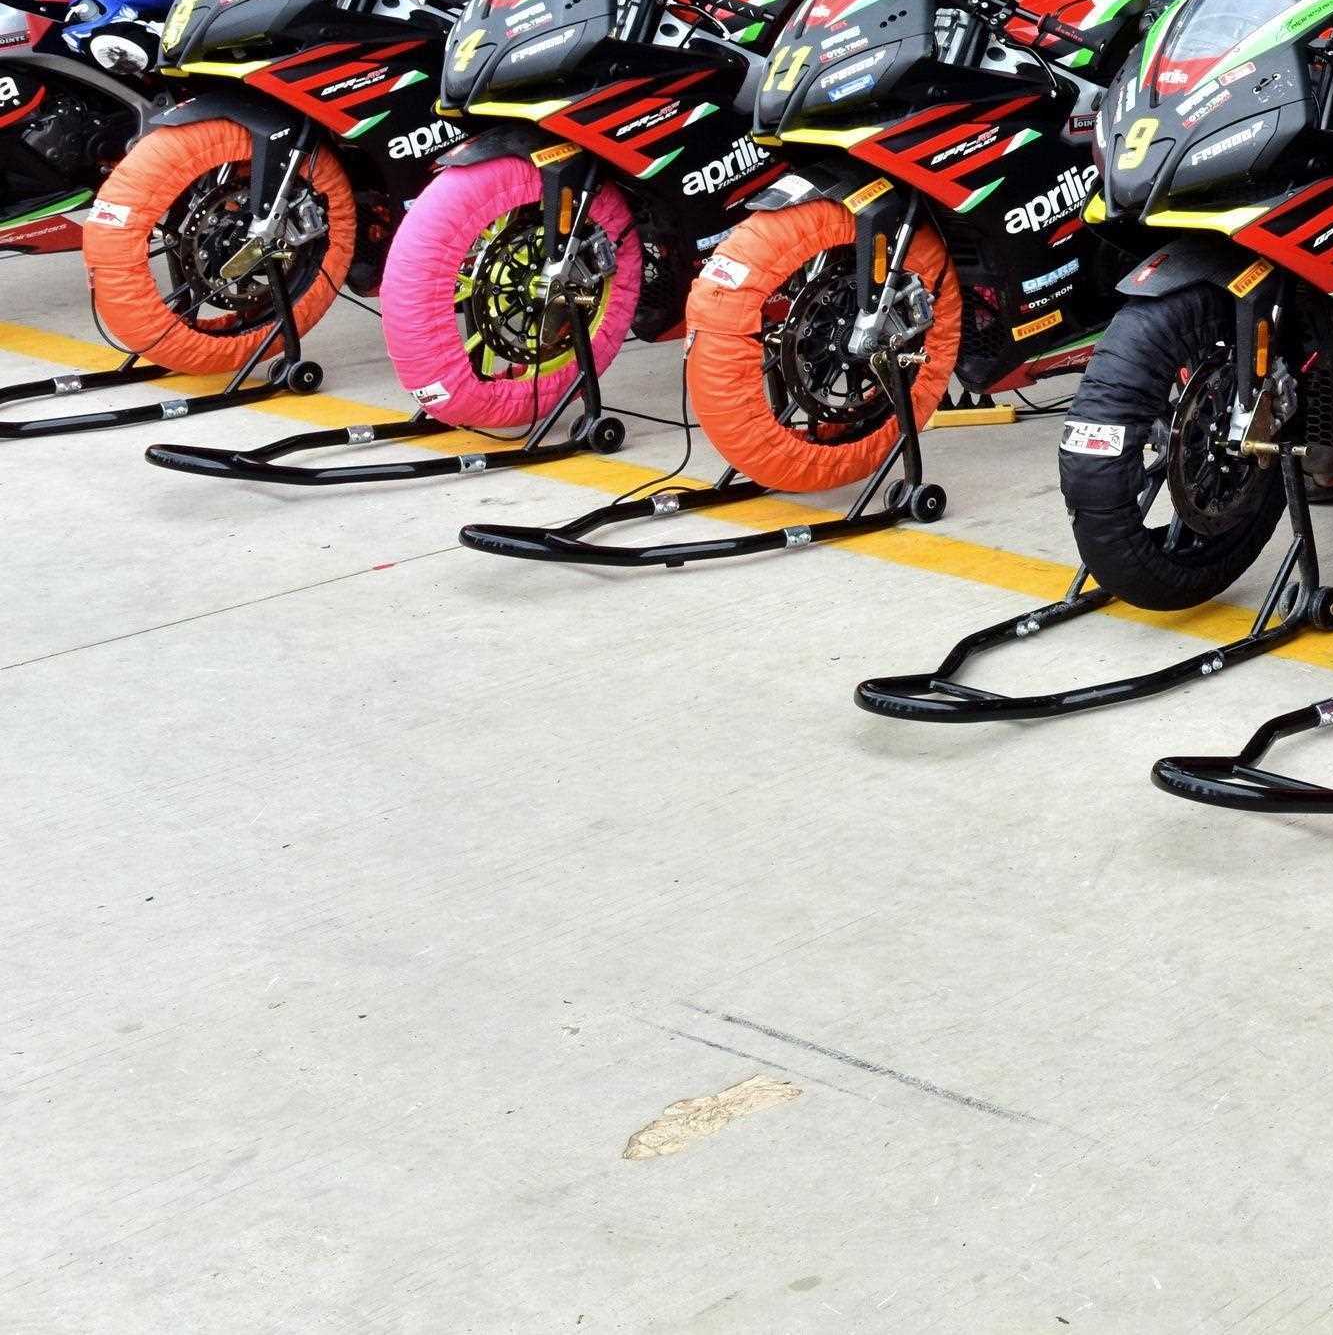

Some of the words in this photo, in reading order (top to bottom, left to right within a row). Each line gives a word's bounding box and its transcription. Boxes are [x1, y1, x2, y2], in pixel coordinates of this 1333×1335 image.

[453, 28, 488, 73] 4
[762, 44, 814, 93] 11
[1117, 117, 1159, 171] 9
[1020, 283, 1074, 313] MOTO-TRON
[1233, 261, 1268, 295] PIRELLI
